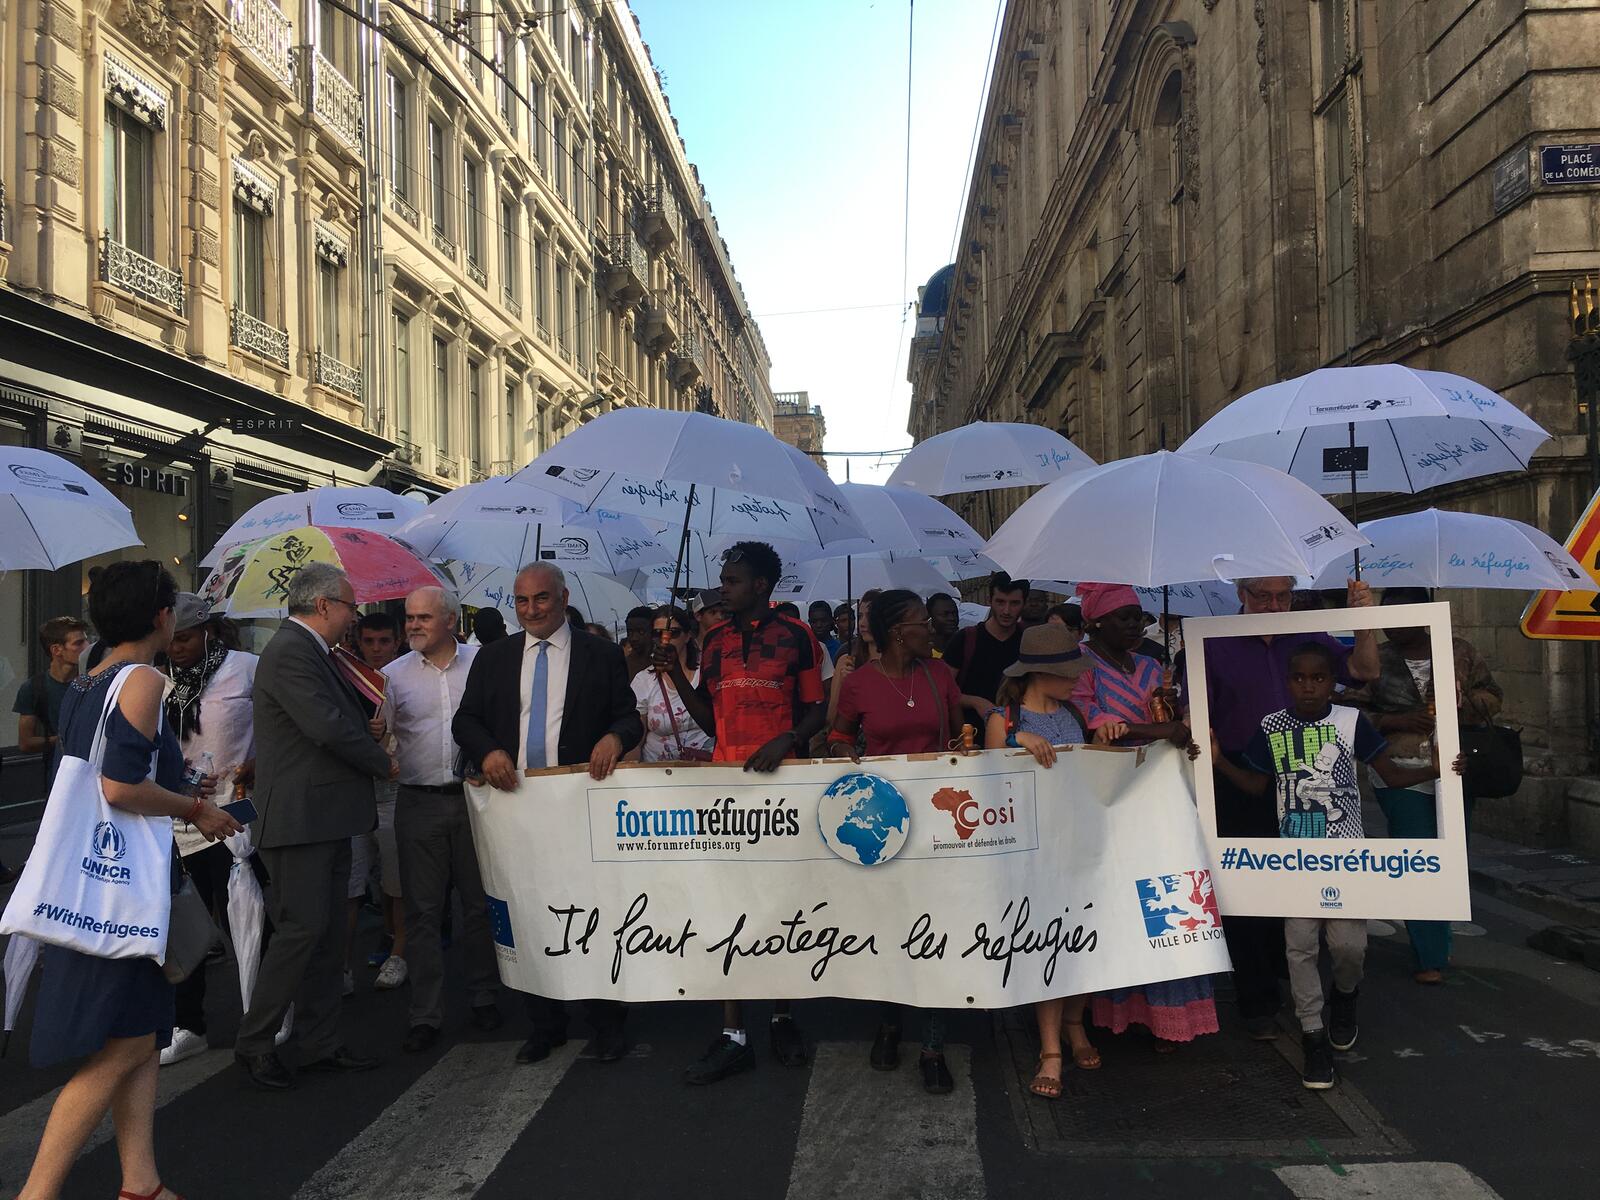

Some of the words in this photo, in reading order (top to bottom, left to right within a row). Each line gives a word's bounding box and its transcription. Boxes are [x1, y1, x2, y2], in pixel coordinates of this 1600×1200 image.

[1561, 153, 1592, 164] PLACE
[236, 419, 294, 429] ESPRIT
[107, 462, 190, 497] ESPRIT
[1471, 552, 1530, 577] réfugiés
[616, 797, 800, 844] forumréfugiés
[958, 798, 1015, 828] Cosi
[617, 839, 741, 852] www.forumrefugies.org
[934, 841, 966, 851] promouvoir
[974, 838, 998, 848] défendre
[1220, 847, 1441, 878] #Aveclesréfugiés
[33, 902, 160, 938] #WithRefugees
[544, 904, 599, 957] Il
[611, 892, 698, 985] faut
[706, 901, 879, 982] protéger
[900, 912, 948, 960] les
[961, 895, 1098, 989] réfugiés
[1149, 935, 1180, 949] VILLE
[1183, 932, 1198, 944] DE
